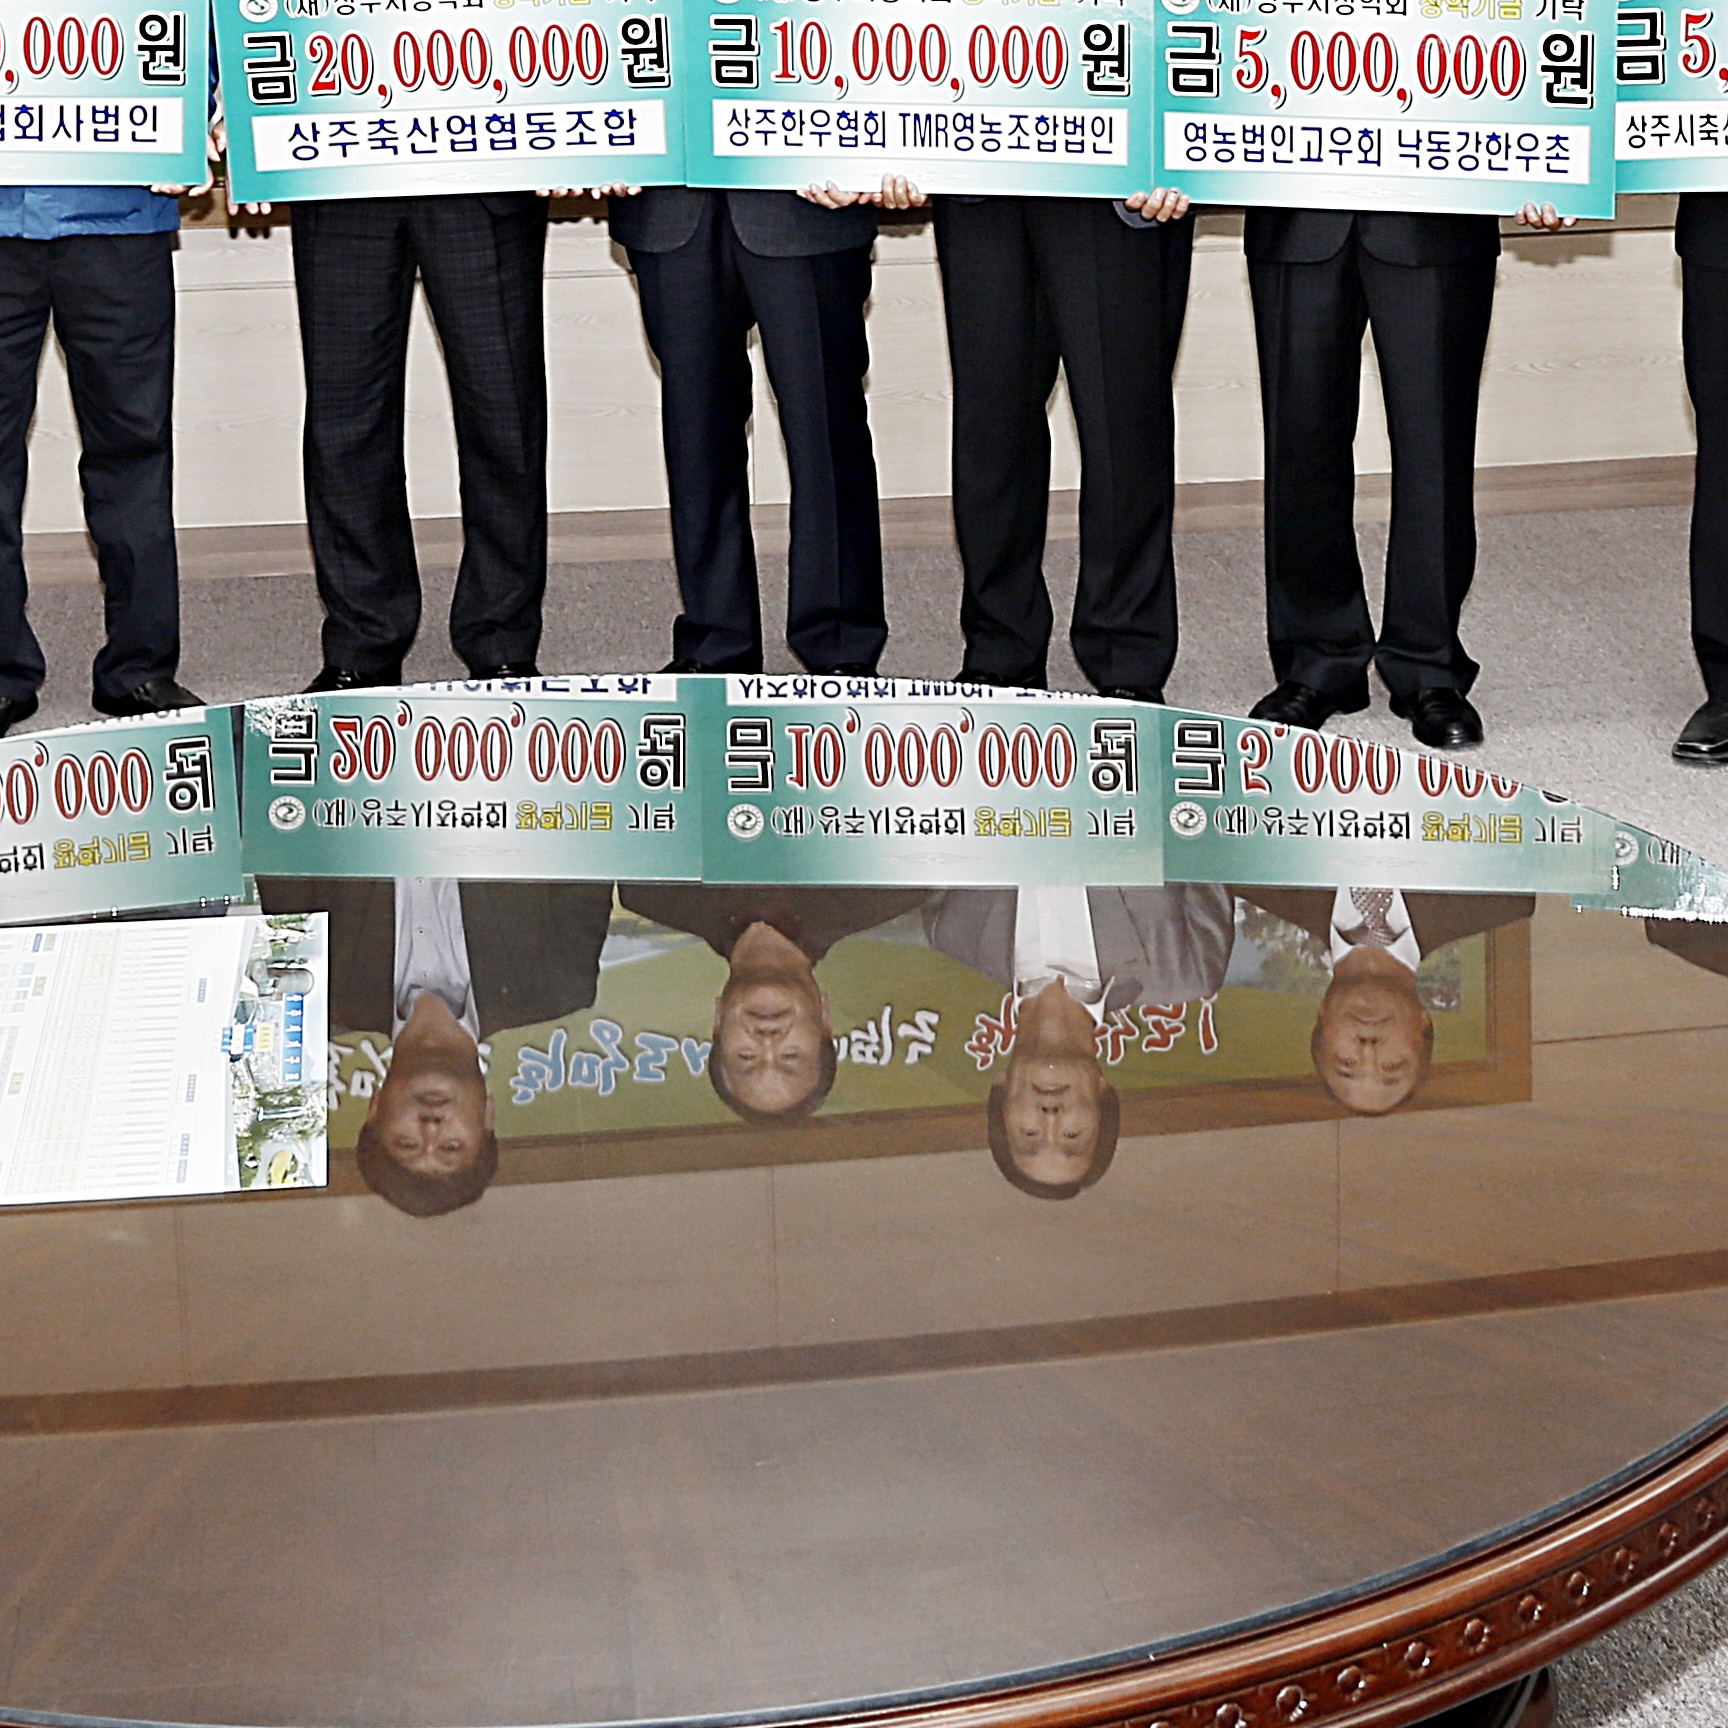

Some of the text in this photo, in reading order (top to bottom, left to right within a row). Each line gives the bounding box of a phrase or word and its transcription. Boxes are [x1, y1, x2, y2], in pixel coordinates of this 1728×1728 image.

[136, 13, 185, 84] 원
[244, 16, 670, 106] 금 20,000,000 원
[708, 16, 1130, 99] 금 10,000,000 원
[1166, 23, 1594, 111] 금 5,000,000 원
[1616, 8, 1665, 84] 금
[288, 109, 637, 161] 상주축산업협동조합
[727, 108, 1113, 153] 상주한우협회 TMR영농조합법인
[1184, 123, 1570, 173] 영농법인고우회 낙동강한우촌
